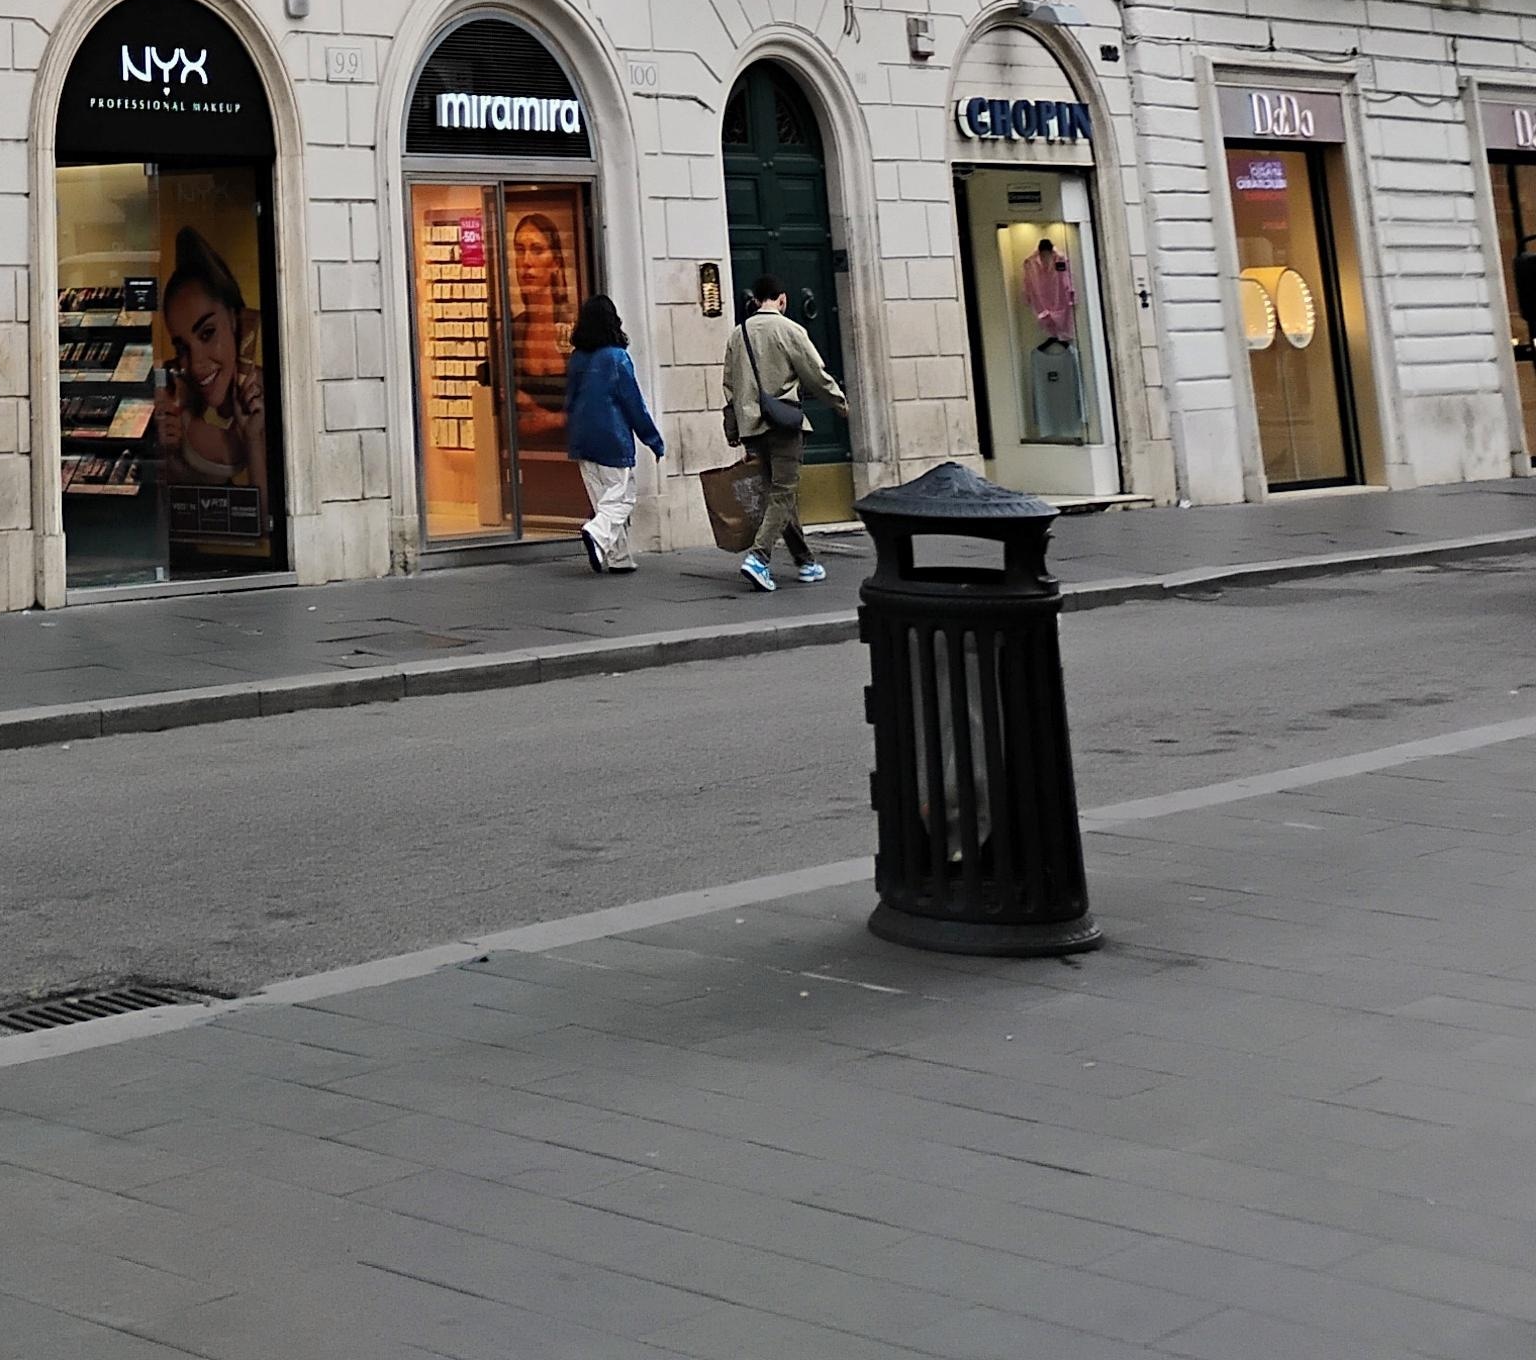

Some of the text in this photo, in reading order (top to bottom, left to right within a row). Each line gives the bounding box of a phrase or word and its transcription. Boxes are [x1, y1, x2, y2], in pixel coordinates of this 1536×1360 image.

[121, 44, 209, 85] NYX
[334, 52, 359, 75] 99
[629, 64, 657, 87] 100
[89, 97, 242, 114] PROFESSIONAL MAKEUP
[437, 92, 581, 134] miramira
[966, 96, 1093, 141] CHOPIN
